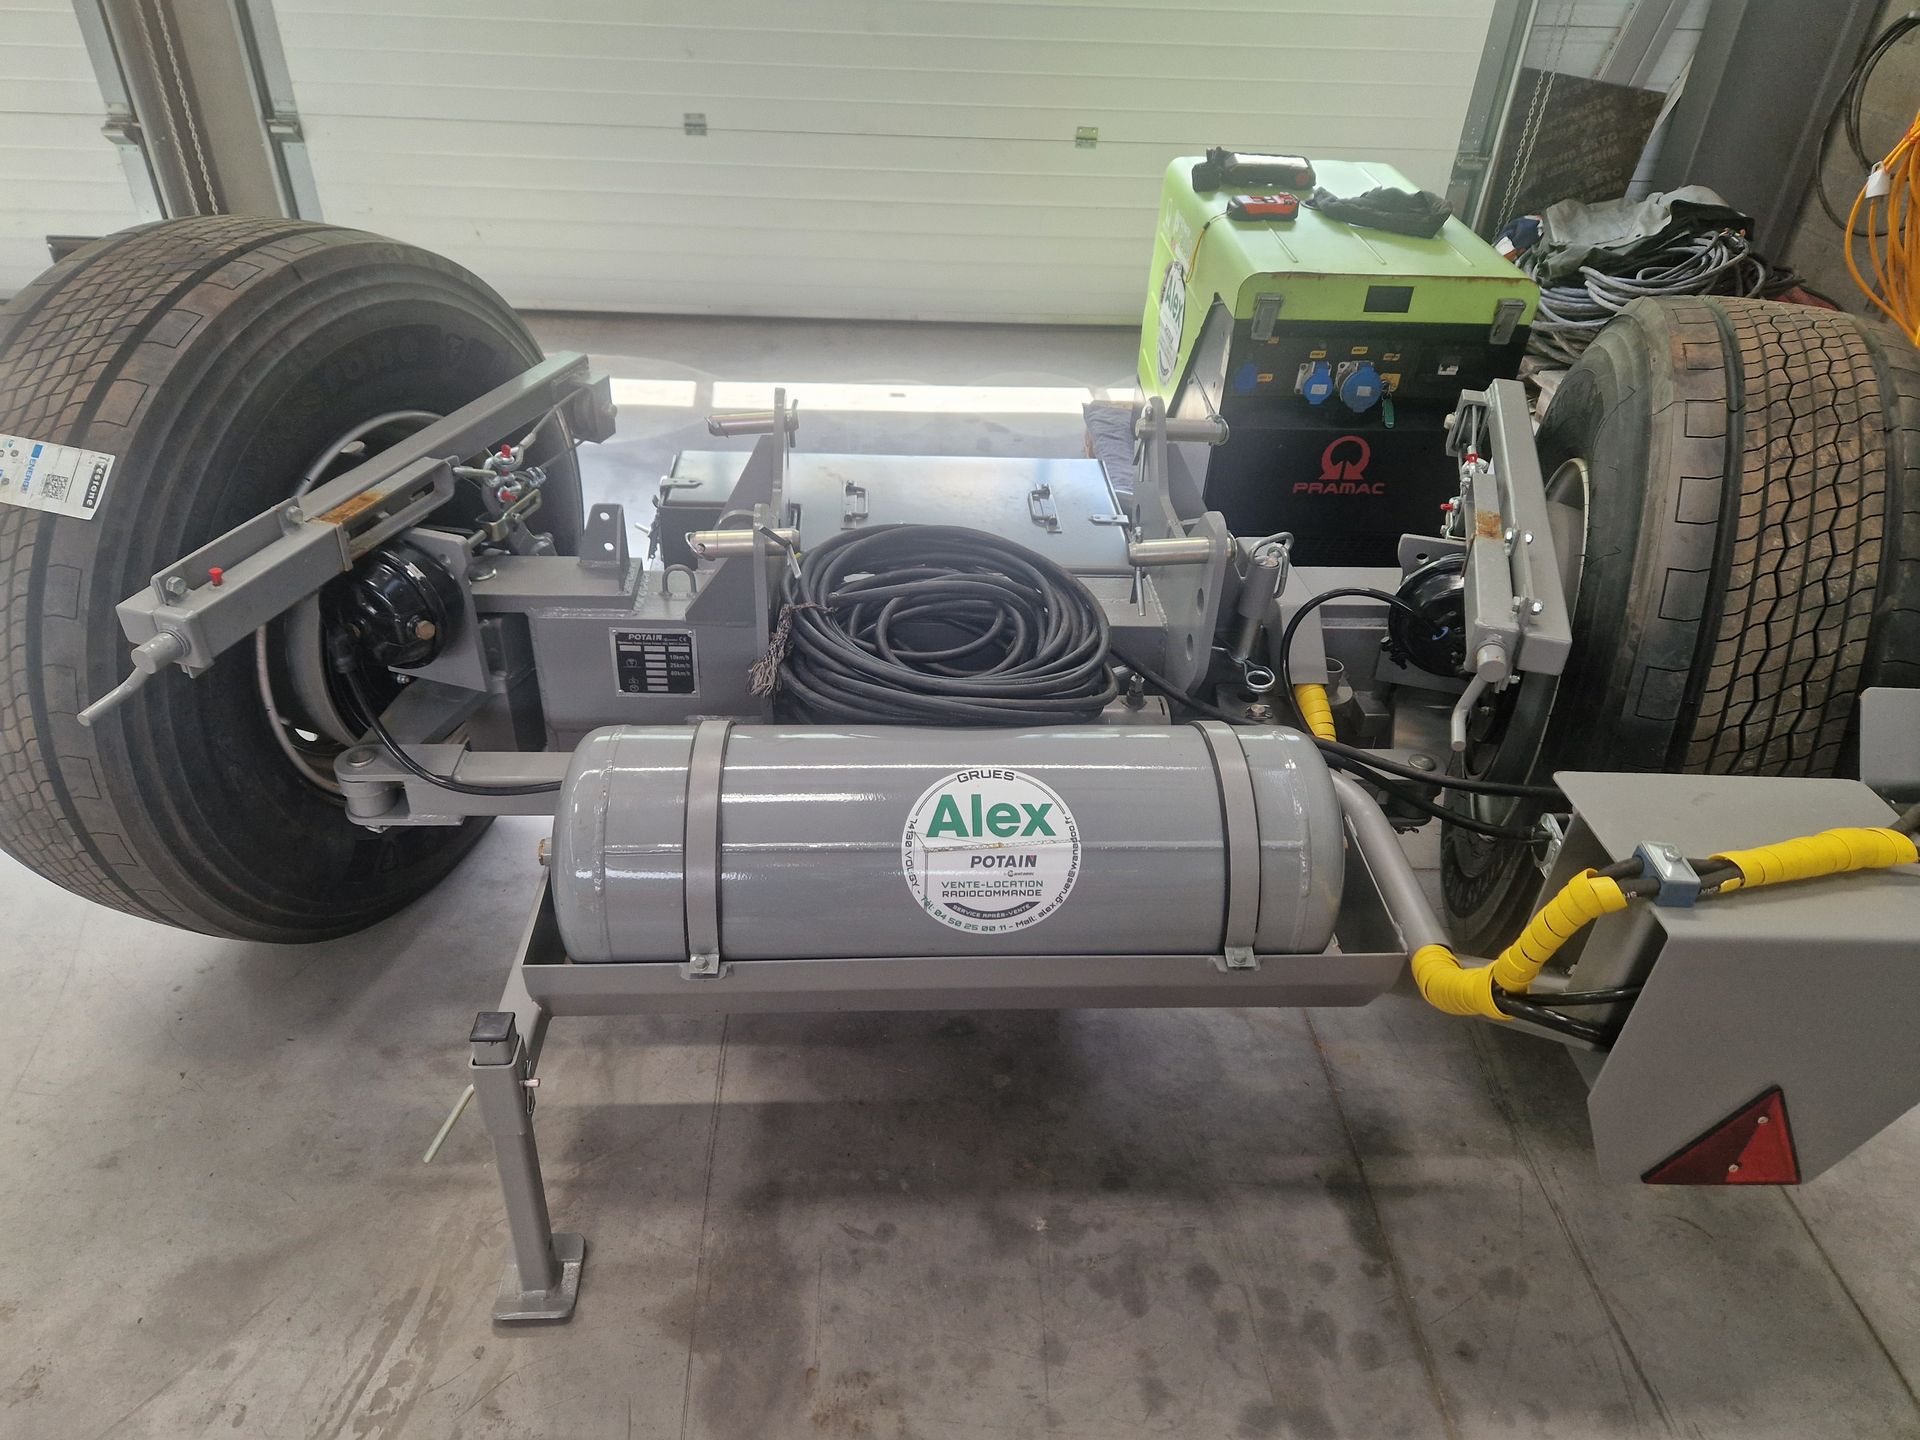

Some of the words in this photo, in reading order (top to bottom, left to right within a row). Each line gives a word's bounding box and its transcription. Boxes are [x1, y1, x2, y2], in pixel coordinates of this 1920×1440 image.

[1165, 275, 1183, 328] Alex
[1293, 482, 1385, 494] PRAMAC
[957, 770, 1015, 783] GRUES
[926, 794, 1057, 838] Alex
[970, 855, 1038, 868] POTAIN
[905, 818, 918, 847] 74130
[934, 909, 947, 920] 04
[947, 917, 962, 927] 50
[963, 922, 978, 931] 25
[981, 924, 996, 932] 00
[1015, 915, 1037, 928] Mail:
[941, 880, 1044, 889] VENTE-LOCATION
[942, 889, 1042, 898] RADIOCOMMANDE
[953, 904, 981, 918] SERVICE
